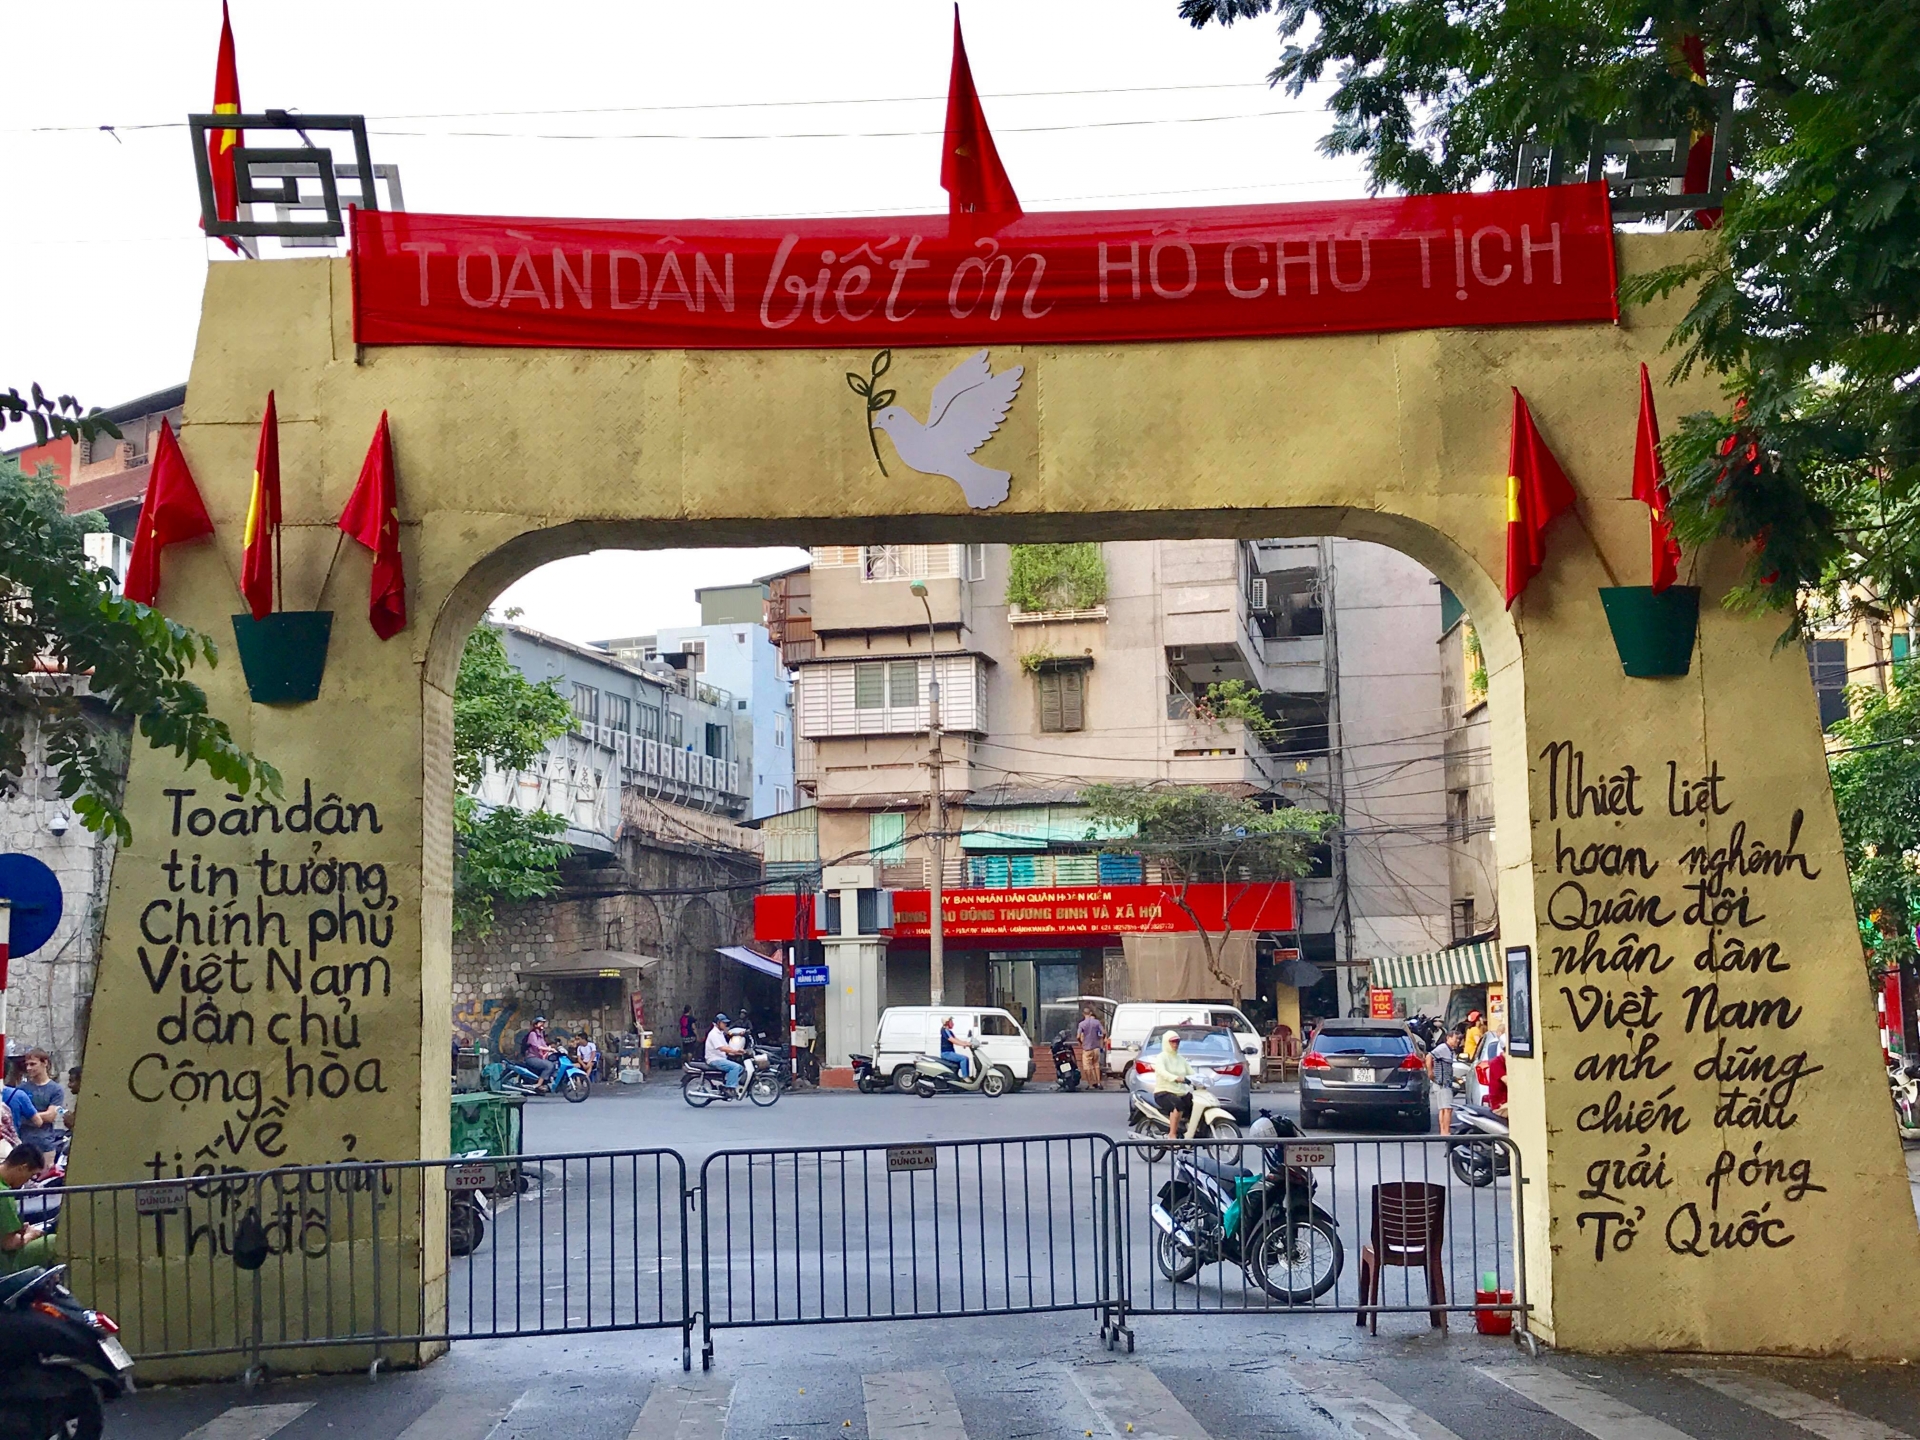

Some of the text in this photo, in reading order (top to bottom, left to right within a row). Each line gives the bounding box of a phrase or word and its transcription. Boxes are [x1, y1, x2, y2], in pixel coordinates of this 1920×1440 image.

[760, 233, 931, 329] biết
[1539, 740, 1735, 828] Nhiệt liệt
[161, 840, 389, 910] tin tưởng
[1555, 808, 1822, 898] hoan nghênh
[139, 892, 399, 961] Chính phủ
[954, 896, 975, 905] BAN
[960, 906, 995, 923] ĐỘNG
[1092, 904, 1110, 919] VÀ
[1115, 903, 1135, 919] XÃ
[1547, 878, 1767, 936] Quân đội
[137, 944, 391, 1001] Việt Nam
[1551, 930, 1791, 976] nhân dân
[156, 994, 361, 1049] dân chủ
[1559, 982, 1803, 1040] Việt Nam
[127, 1046, 388, 1122] Cộng hòa
[1574, 1032, 1824, 1109] anh dũng
[223, 1096, 290, 1158] về
[1577, 1084, 1798, 1135] chiến đấu
[456, 1176, 486, 1186] STOP
[1295, 1154, 1325, 1163] STOP
[1578, 1143, 1674, 1205] giải
[1665, 1201, 1796, 1257] Quốc
